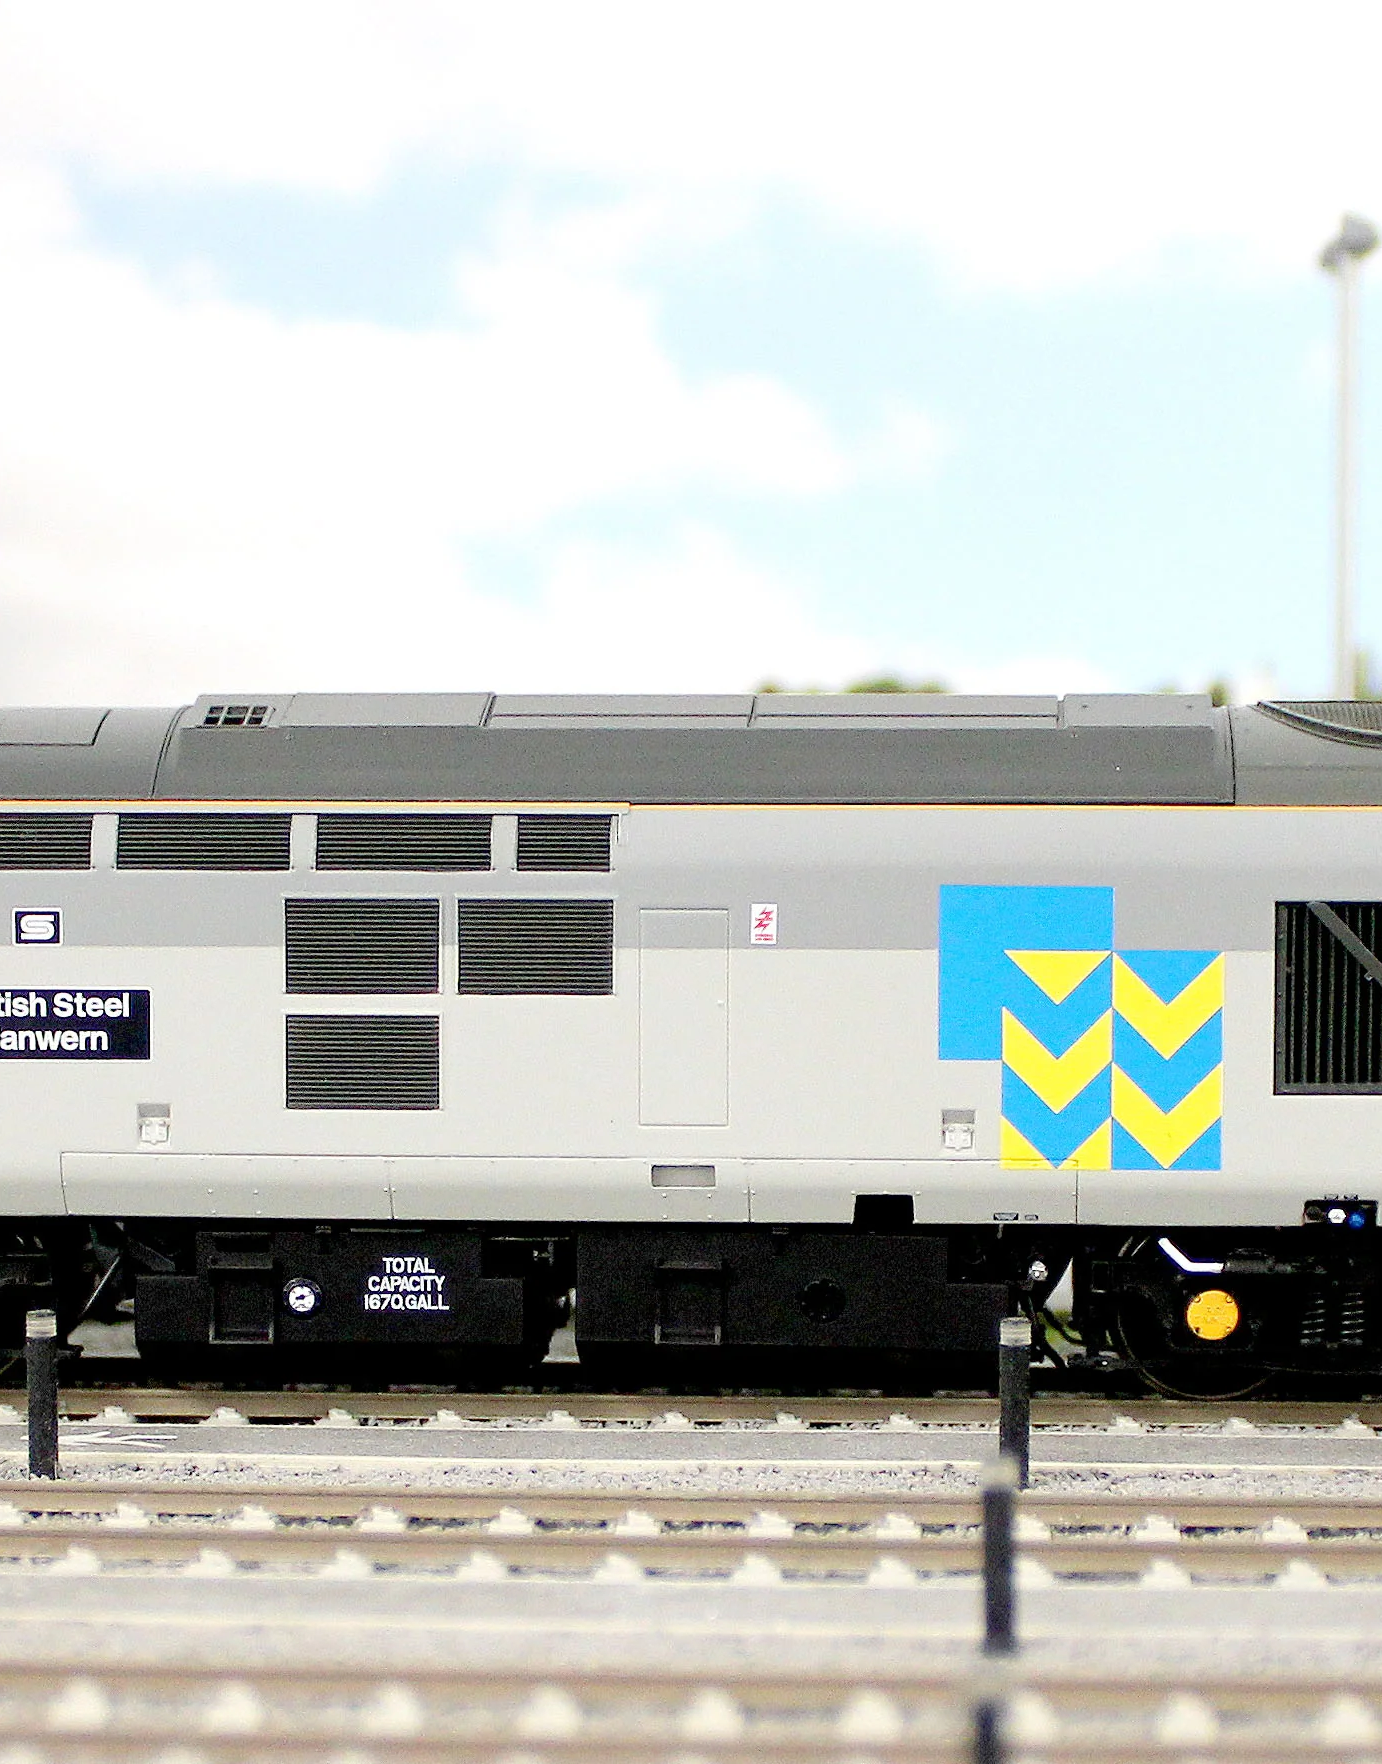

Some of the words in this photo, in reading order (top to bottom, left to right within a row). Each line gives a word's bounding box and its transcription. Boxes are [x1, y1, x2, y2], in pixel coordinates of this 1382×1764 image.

[53, 991, 130, 1018] Steel
[382, 1256, 436, 1274] TOTAL
[367, 1275, 446, 1292] CAPACITY
